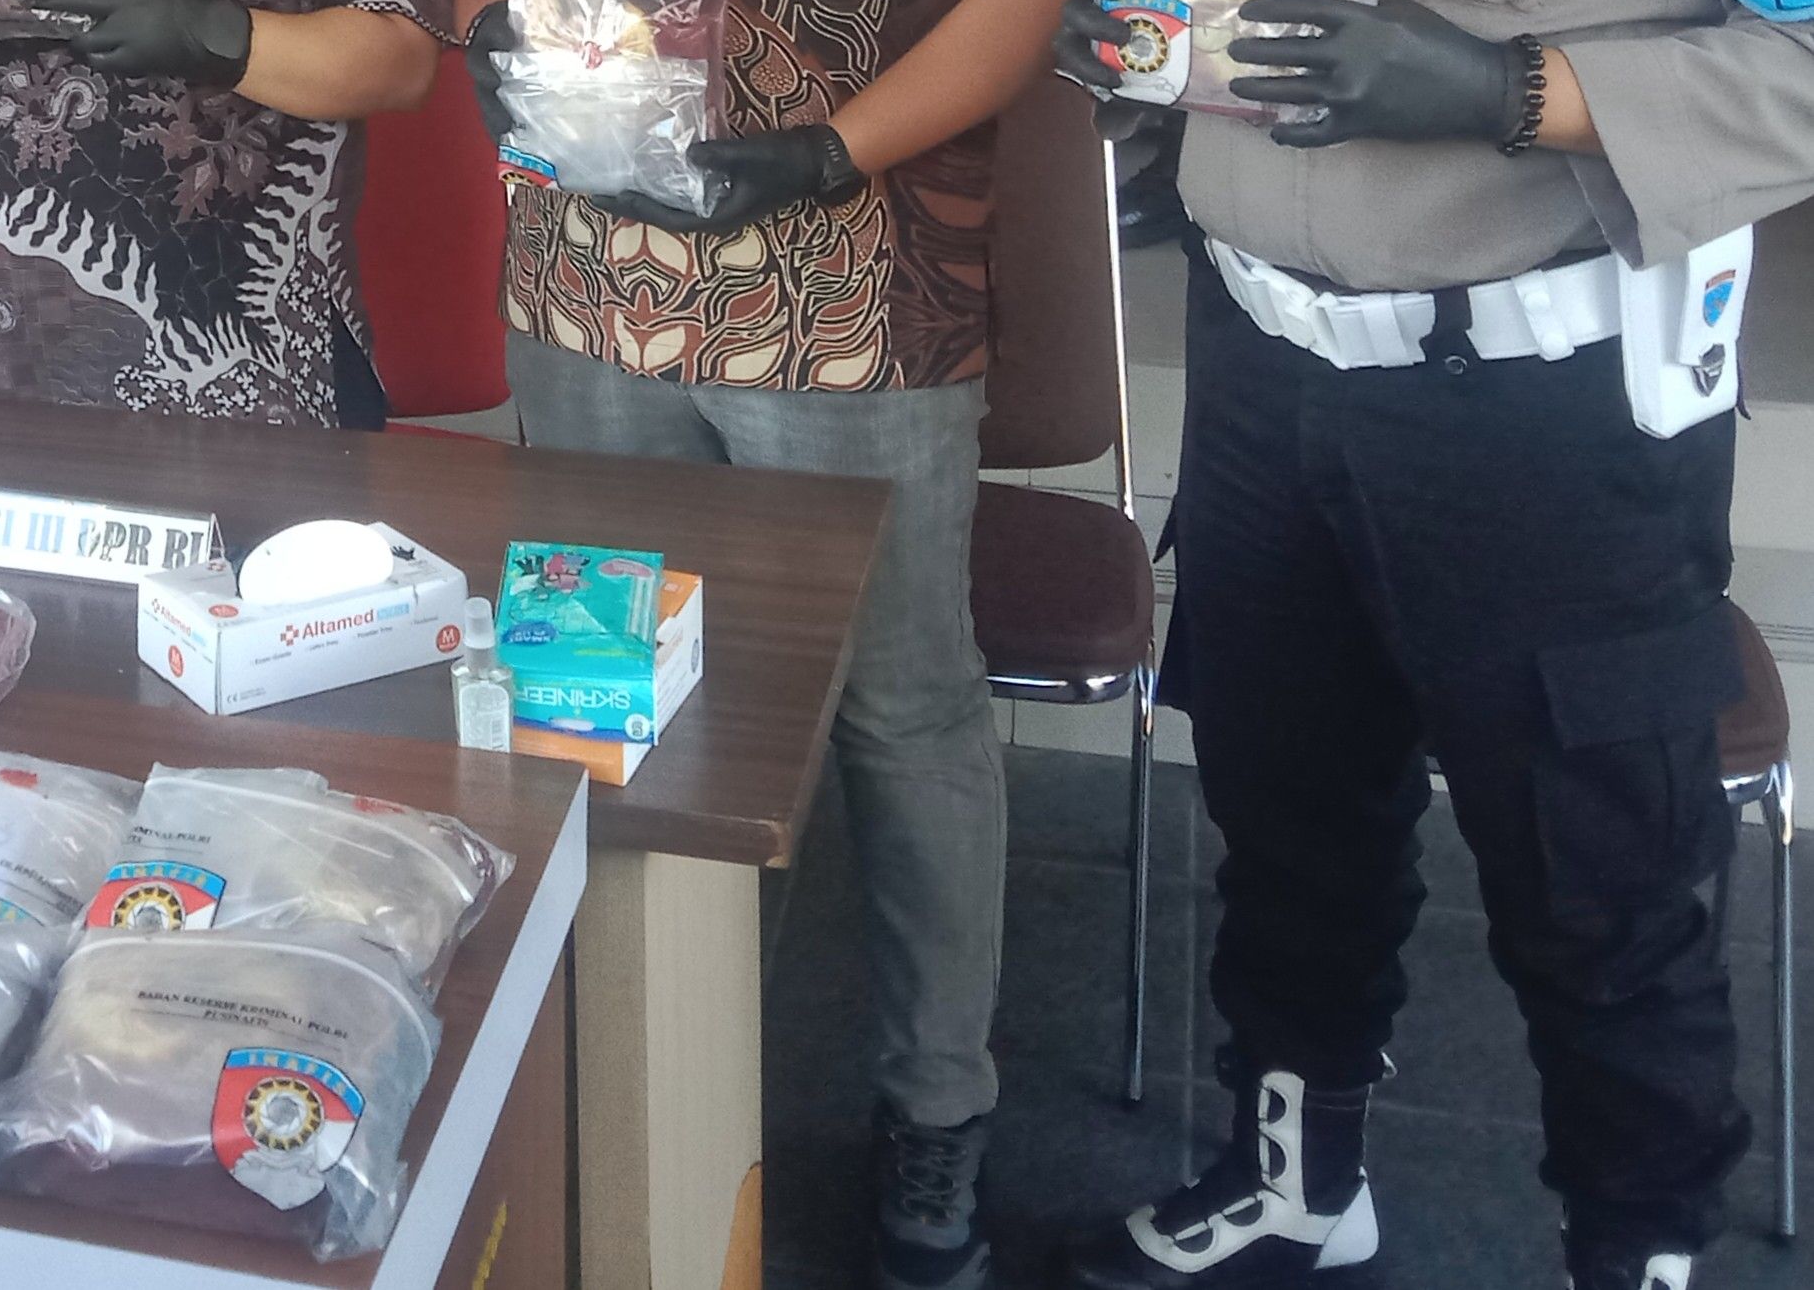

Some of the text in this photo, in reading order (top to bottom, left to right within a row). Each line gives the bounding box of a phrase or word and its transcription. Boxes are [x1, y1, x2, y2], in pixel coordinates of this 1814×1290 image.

[26, 513, 66, 553] III
[77, 518, 153, 566] DPR
[162, 528, 204, 569] RI
[302, 609, 374, 640] Altamed
[442, 628, 455, 643] M
[138, 990, 180, 1003] BADAN
[307, 1020, 349, 1039] POLRI
